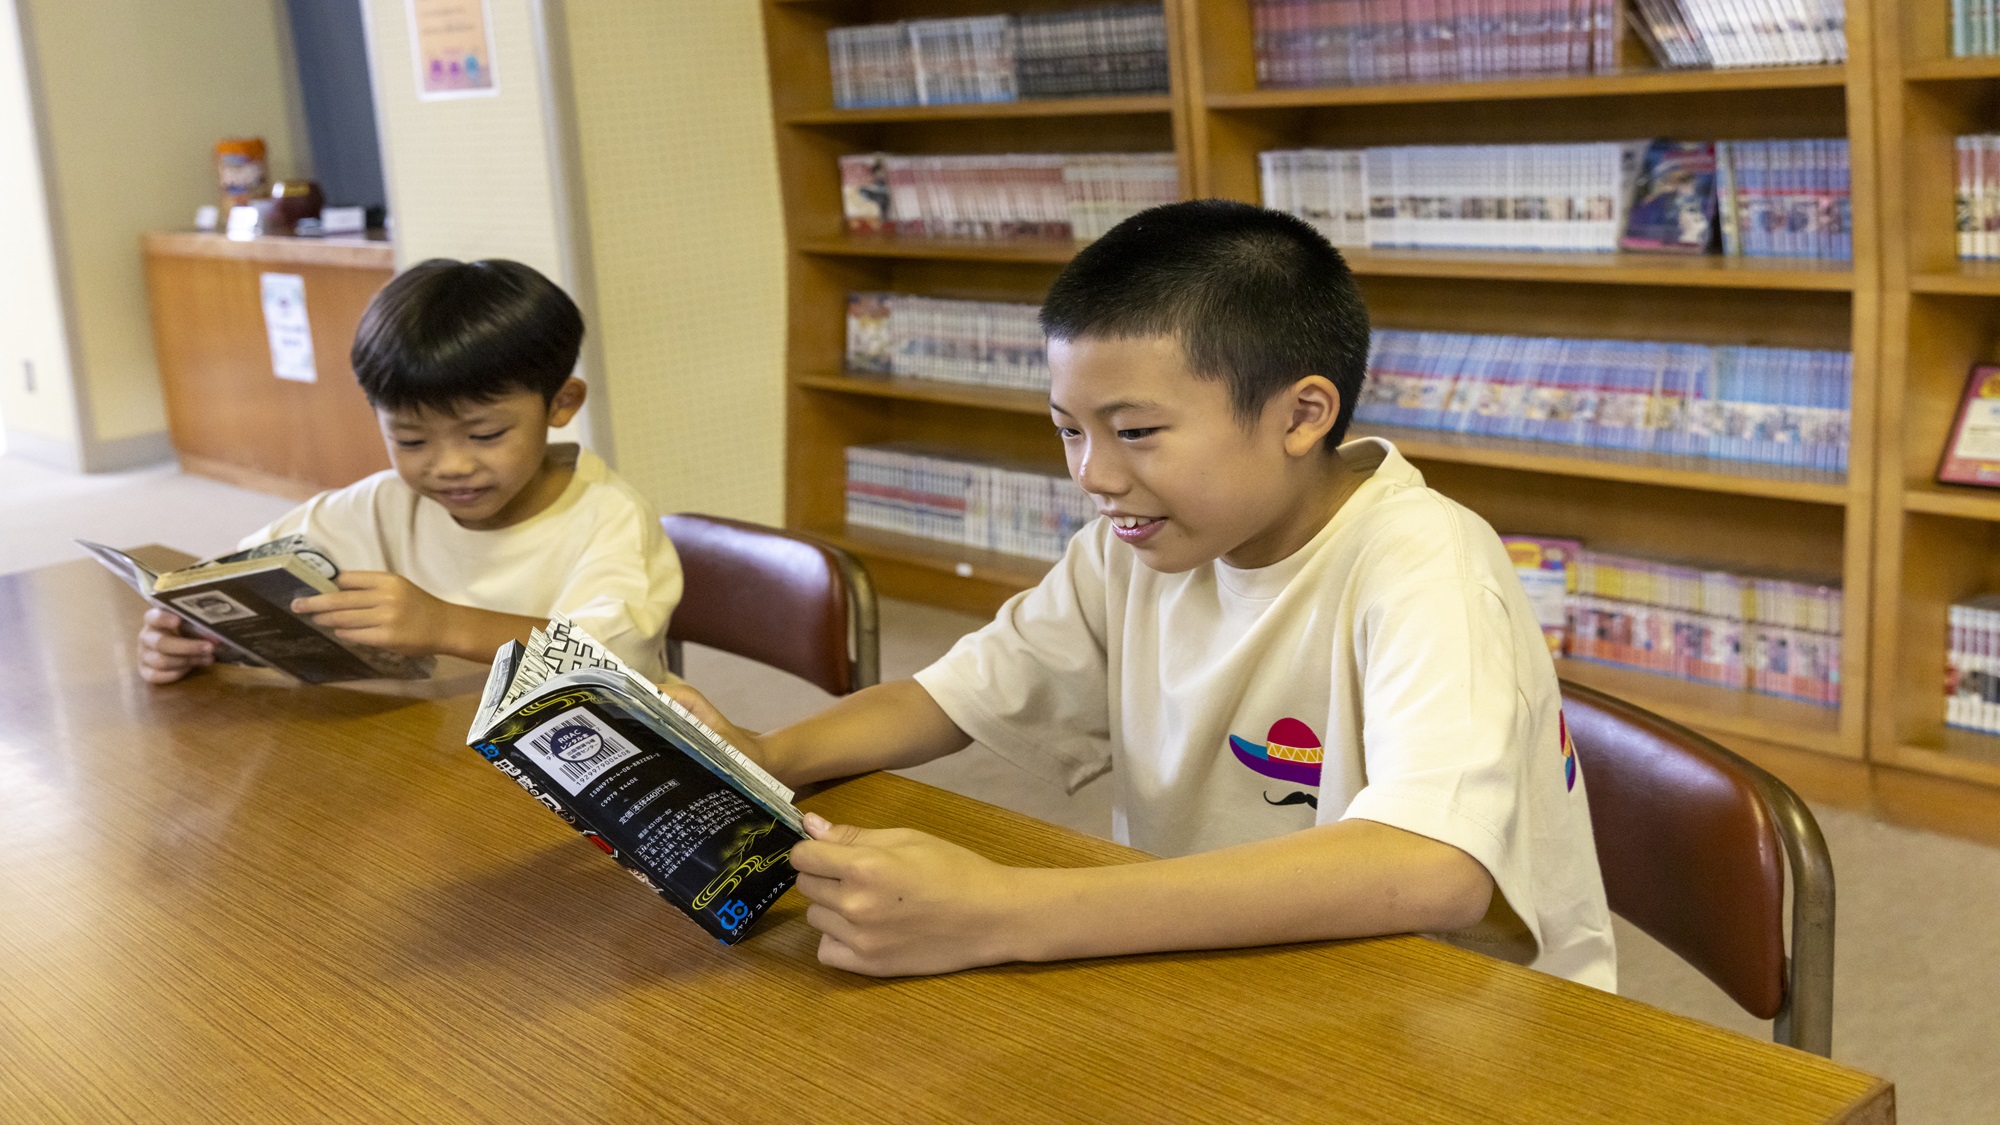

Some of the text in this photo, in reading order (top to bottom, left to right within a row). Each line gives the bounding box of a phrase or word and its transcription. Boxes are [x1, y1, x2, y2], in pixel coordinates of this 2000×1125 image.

[557, 729, 582, 744] RRAC
[560, 733, 589, 750] レンタル本
[576, 749, 631, 786] 1929979004408
[601, 791, 618, 808] C9979
[756, 882, 785, 910] コミックス
